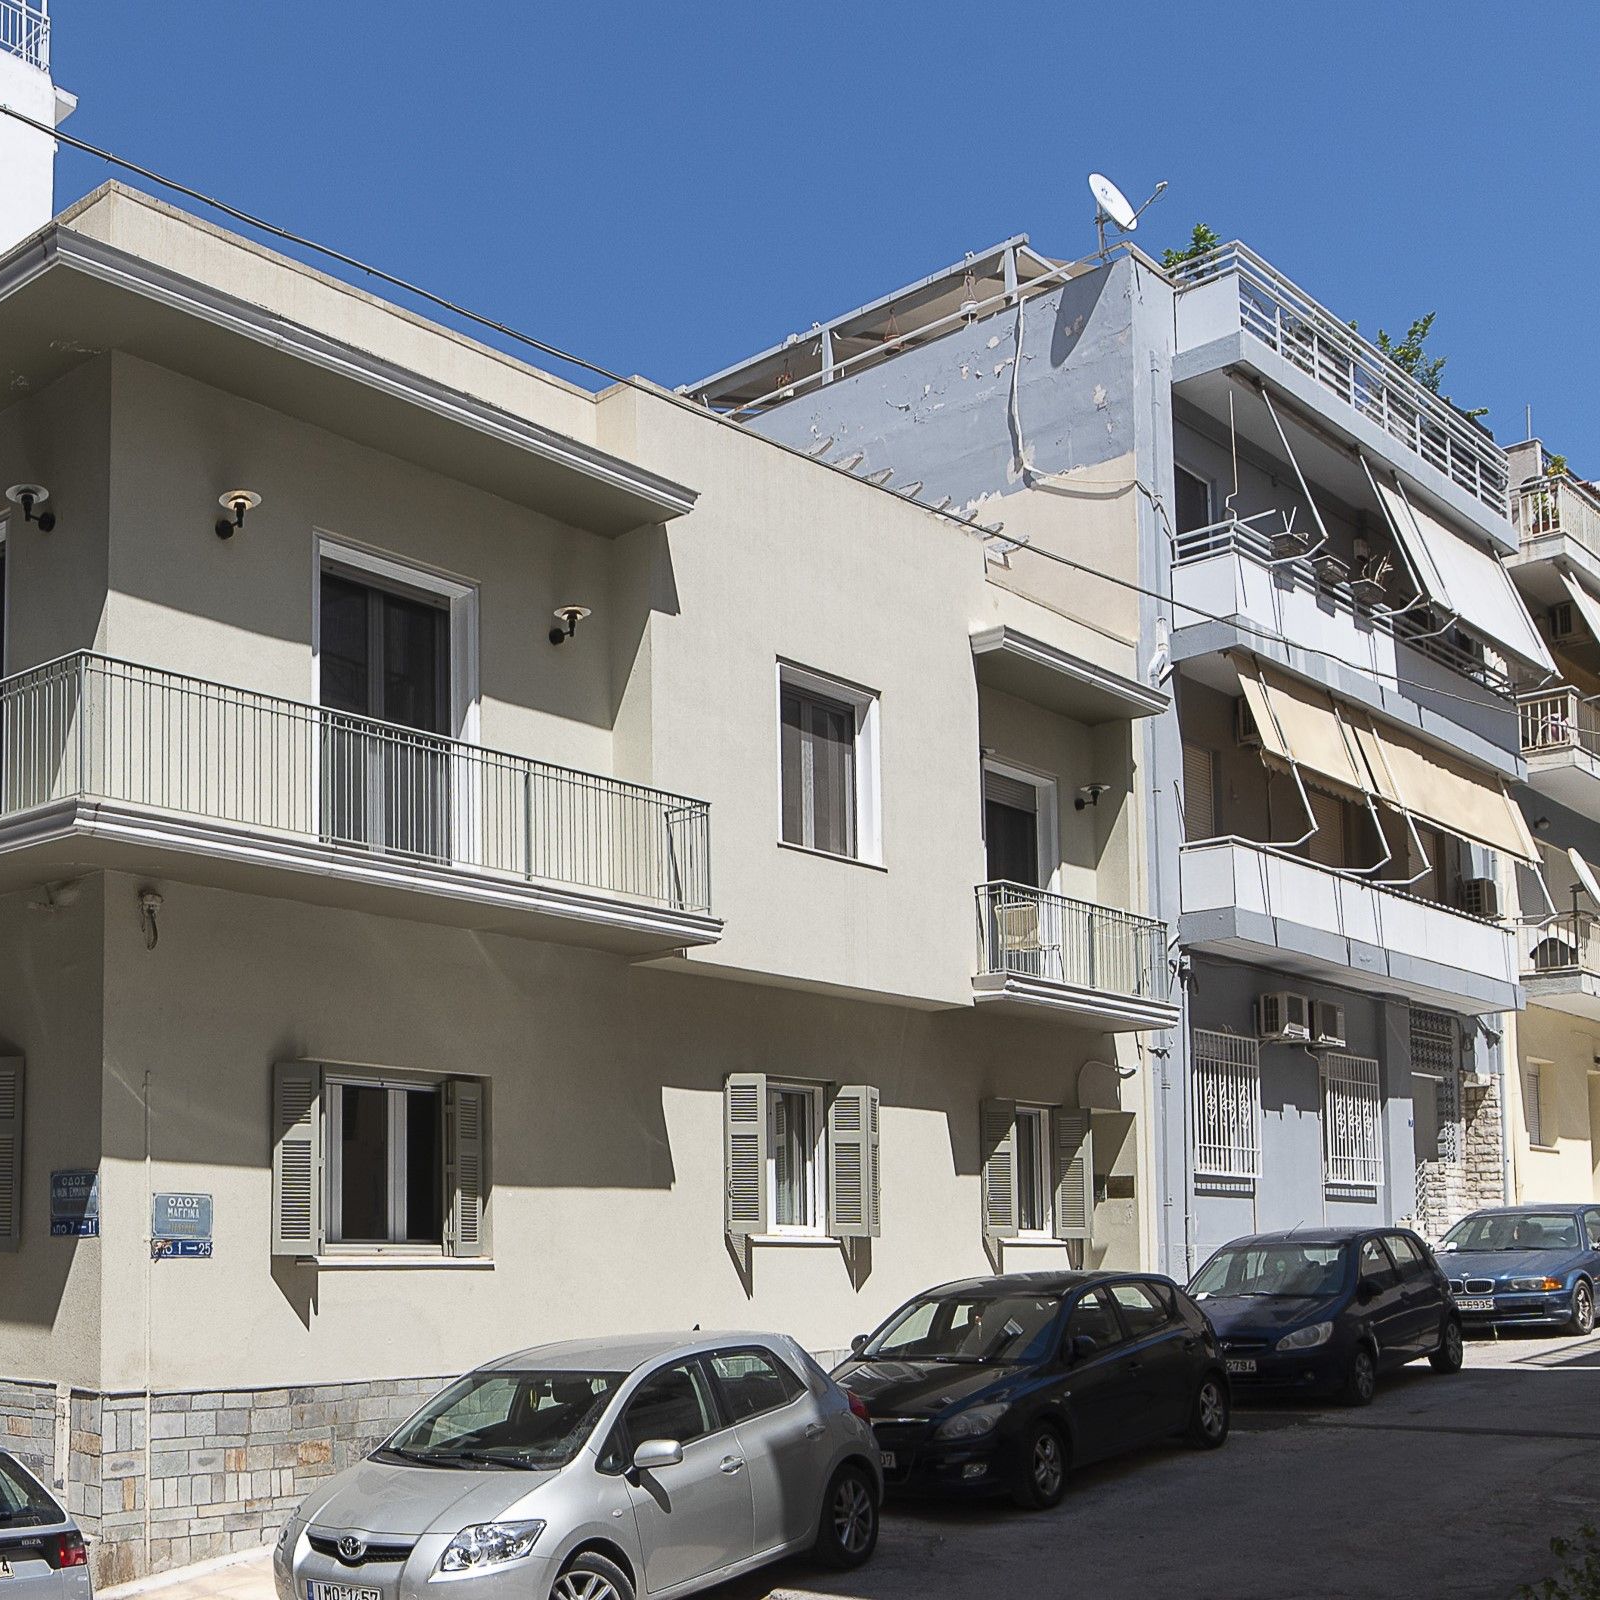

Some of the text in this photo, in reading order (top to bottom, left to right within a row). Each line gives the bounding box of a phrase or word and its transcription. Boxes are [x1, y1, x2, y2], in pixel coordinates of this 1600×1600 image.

[62, 1176, 86, 1186] ΟΔΟΣ
[169, 1197, 199, 1207] ΟΔΟΣ
[167, 1207, 200, 1218] ΜΑΓΓΙΝΑ
[70, 1221, 75, 1234] 7
[178, 1242, 182, 1254] 1
[198, 1242, 211, 1255] 25
